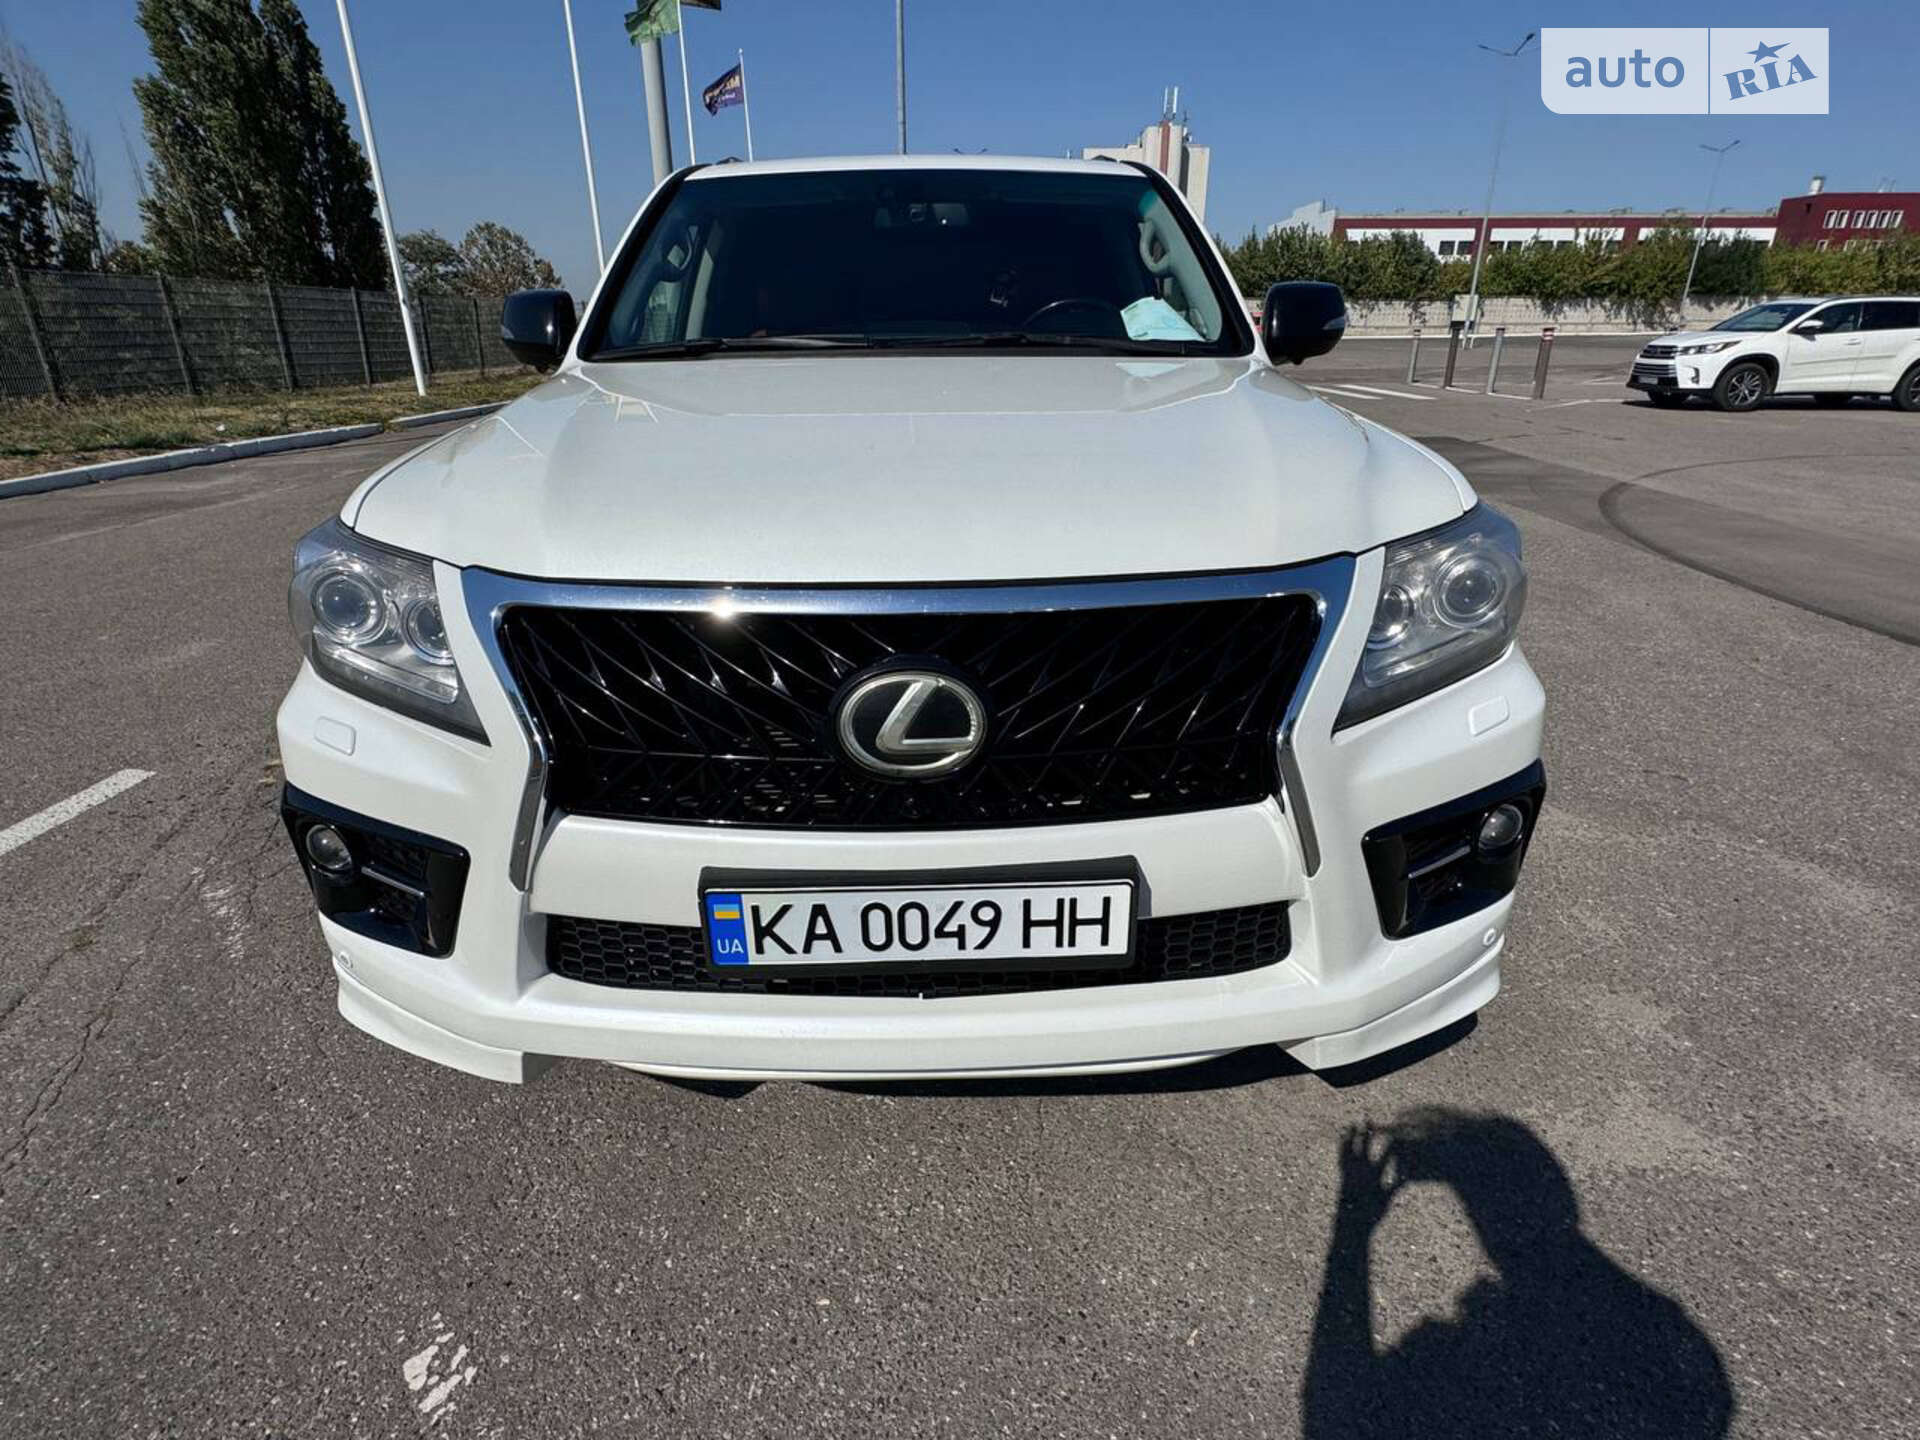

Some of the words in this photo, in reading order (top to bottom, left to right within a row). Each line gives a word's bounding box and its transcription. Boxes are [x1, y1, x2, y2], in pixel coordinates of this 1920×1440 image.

[750, 903, 843, 955] KA
[860, 899, 1002, 952] 0049
[1021, 896, 1111, 949] HH
[717, 938, 745, 956] UA
